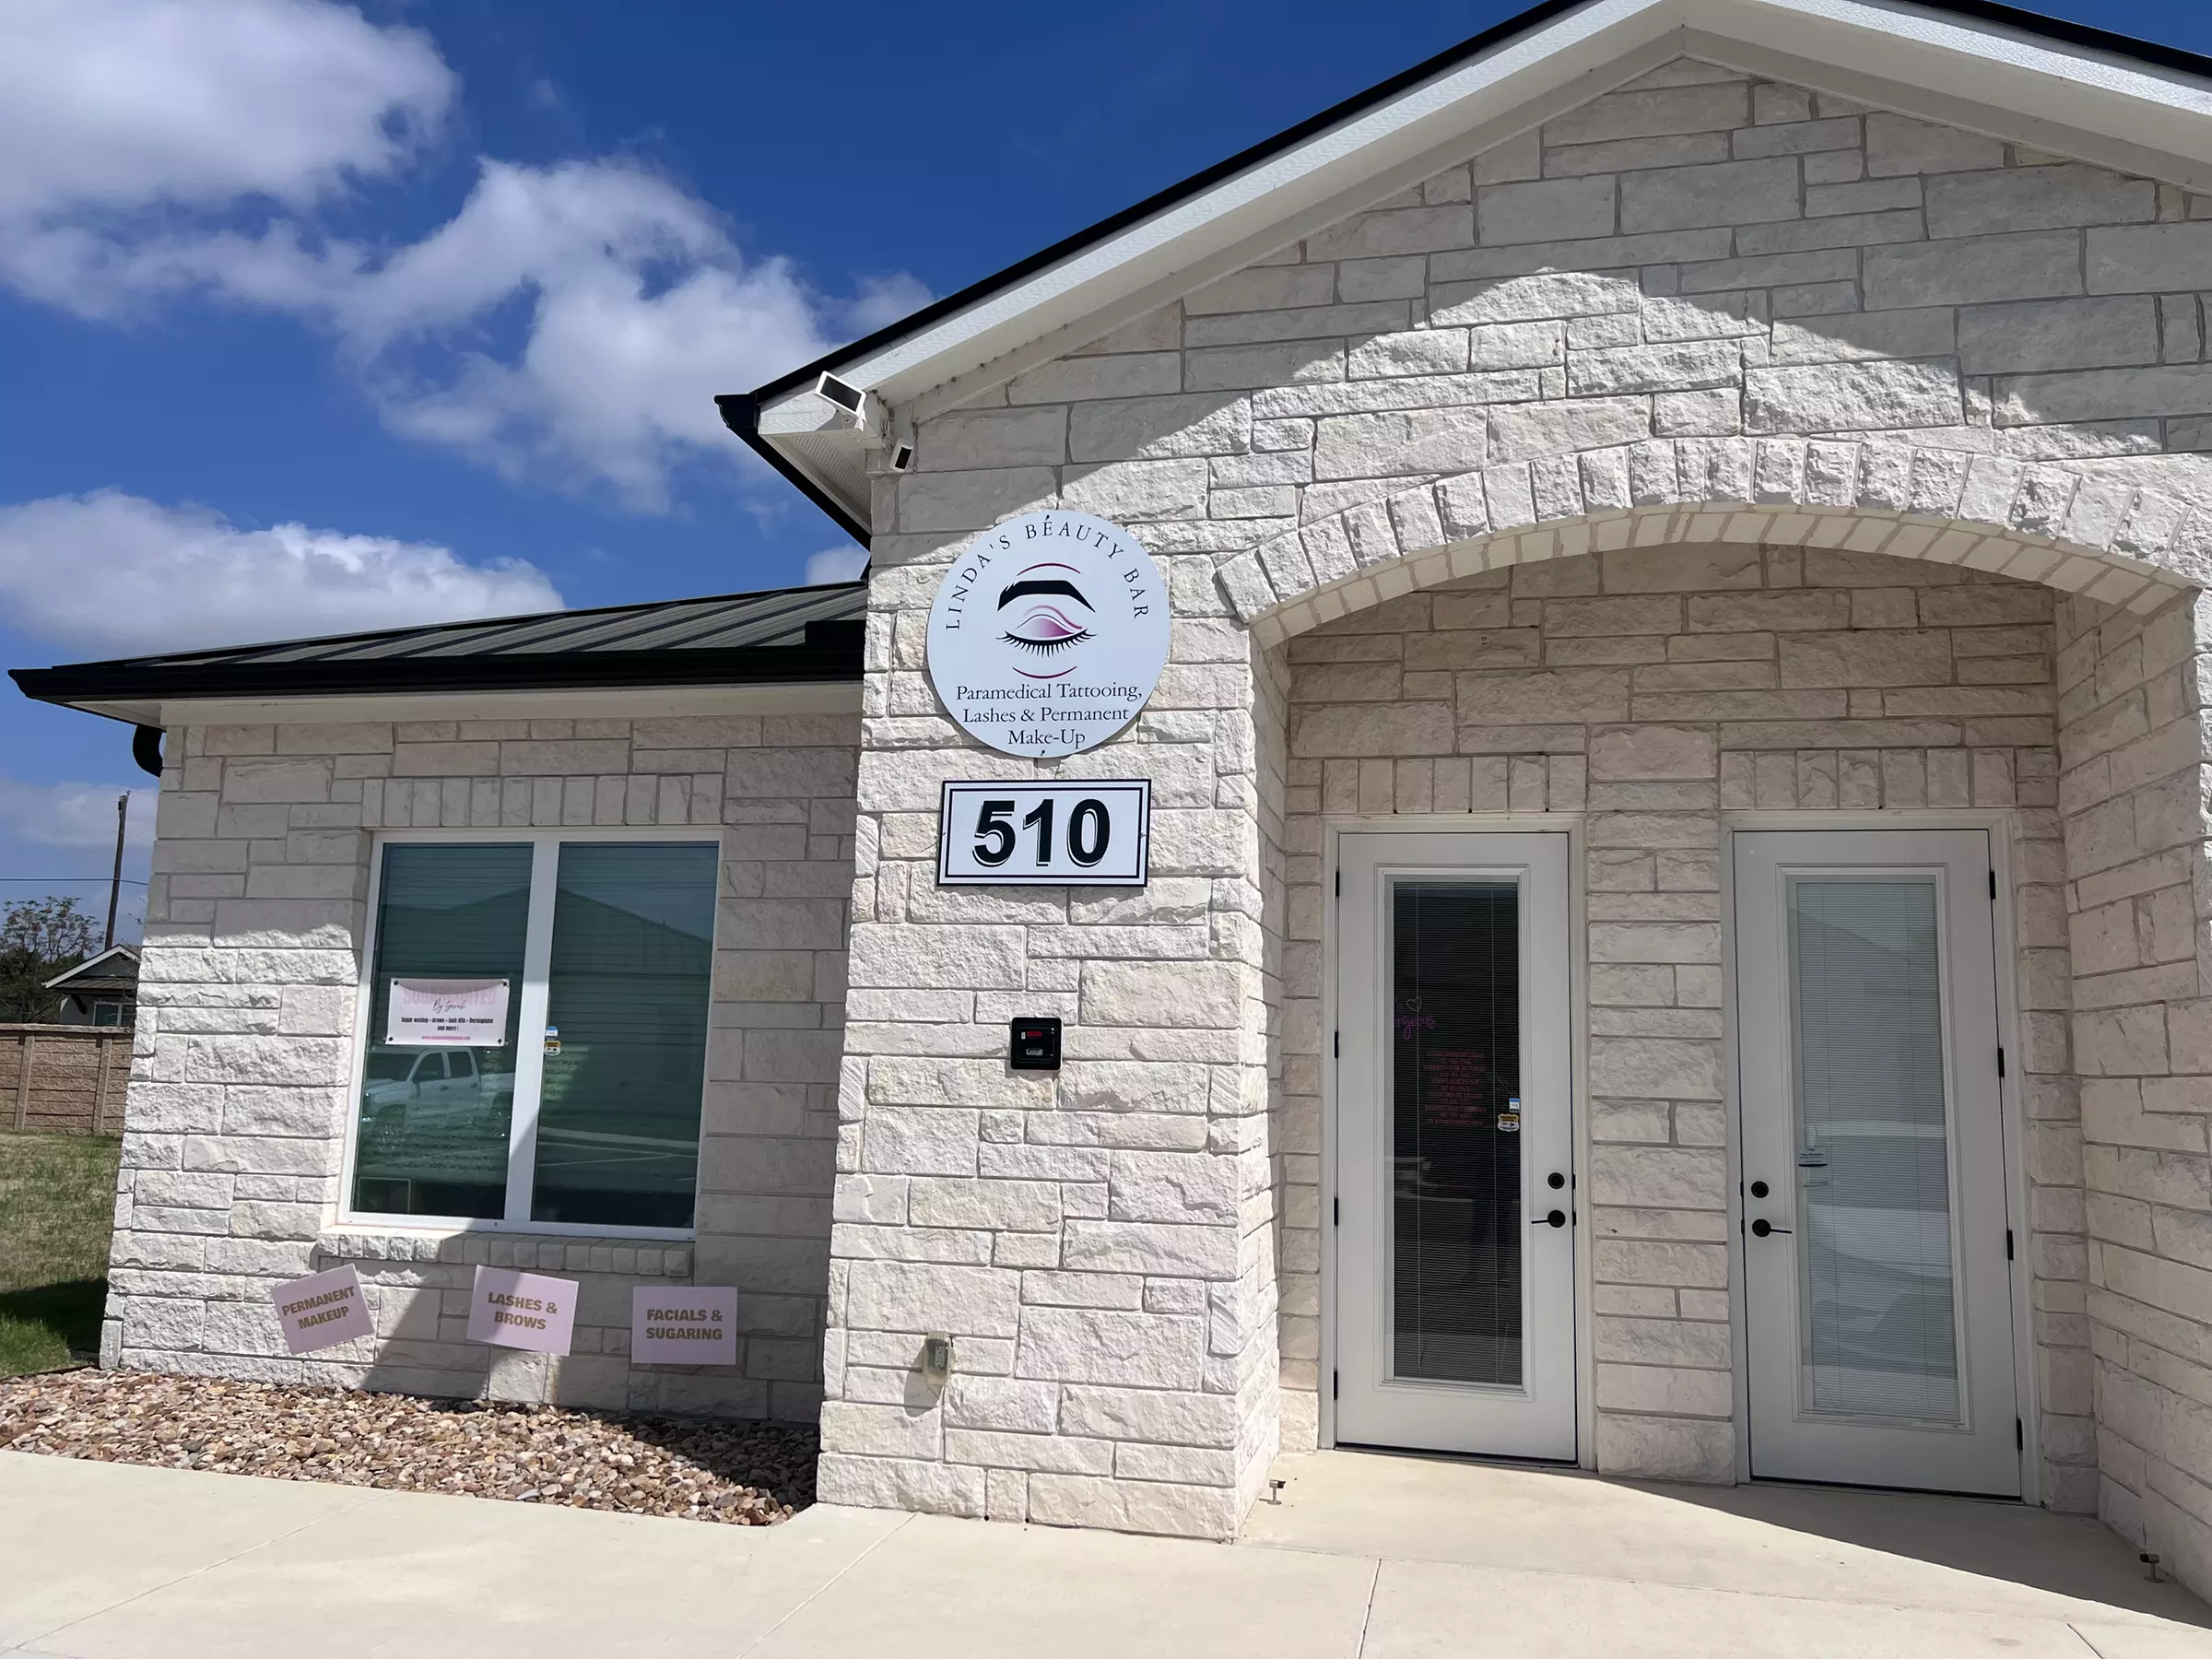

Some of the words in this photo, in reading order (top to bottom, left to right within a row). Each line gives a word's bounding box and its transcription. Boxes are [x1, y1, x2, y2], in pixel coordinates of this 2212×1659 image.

[945, 535, 1012, 630] LINDA'S
[1123, 567, 1149, 619] BAR
[955, 683, 1052, 700] Paramedical
[1055, 681, 1143, 701] Tattooing,
[962, 707, 1017, 724] Lashes
[1019, 708, 1036, 722] &
[1040, 706, 1129, 722] Permanent
[1007, 728, 1086, 749] Make-Up
[971, 798, 1111, 868] 510
[281, 1286, 355, 1316] PERMANENT
[488, 1291, 542, 1312] LASHES
[546, 1301, 558, 1314] &
[298, 1306, 349, 1329] MAKEUP
[494, 1311, 547, 1330] BROWS
[647, 1309, 707, 1322] FACIALS
[711, 1310, 723, 1322] &
[645, 1327, 723, 1340] SUGARING
